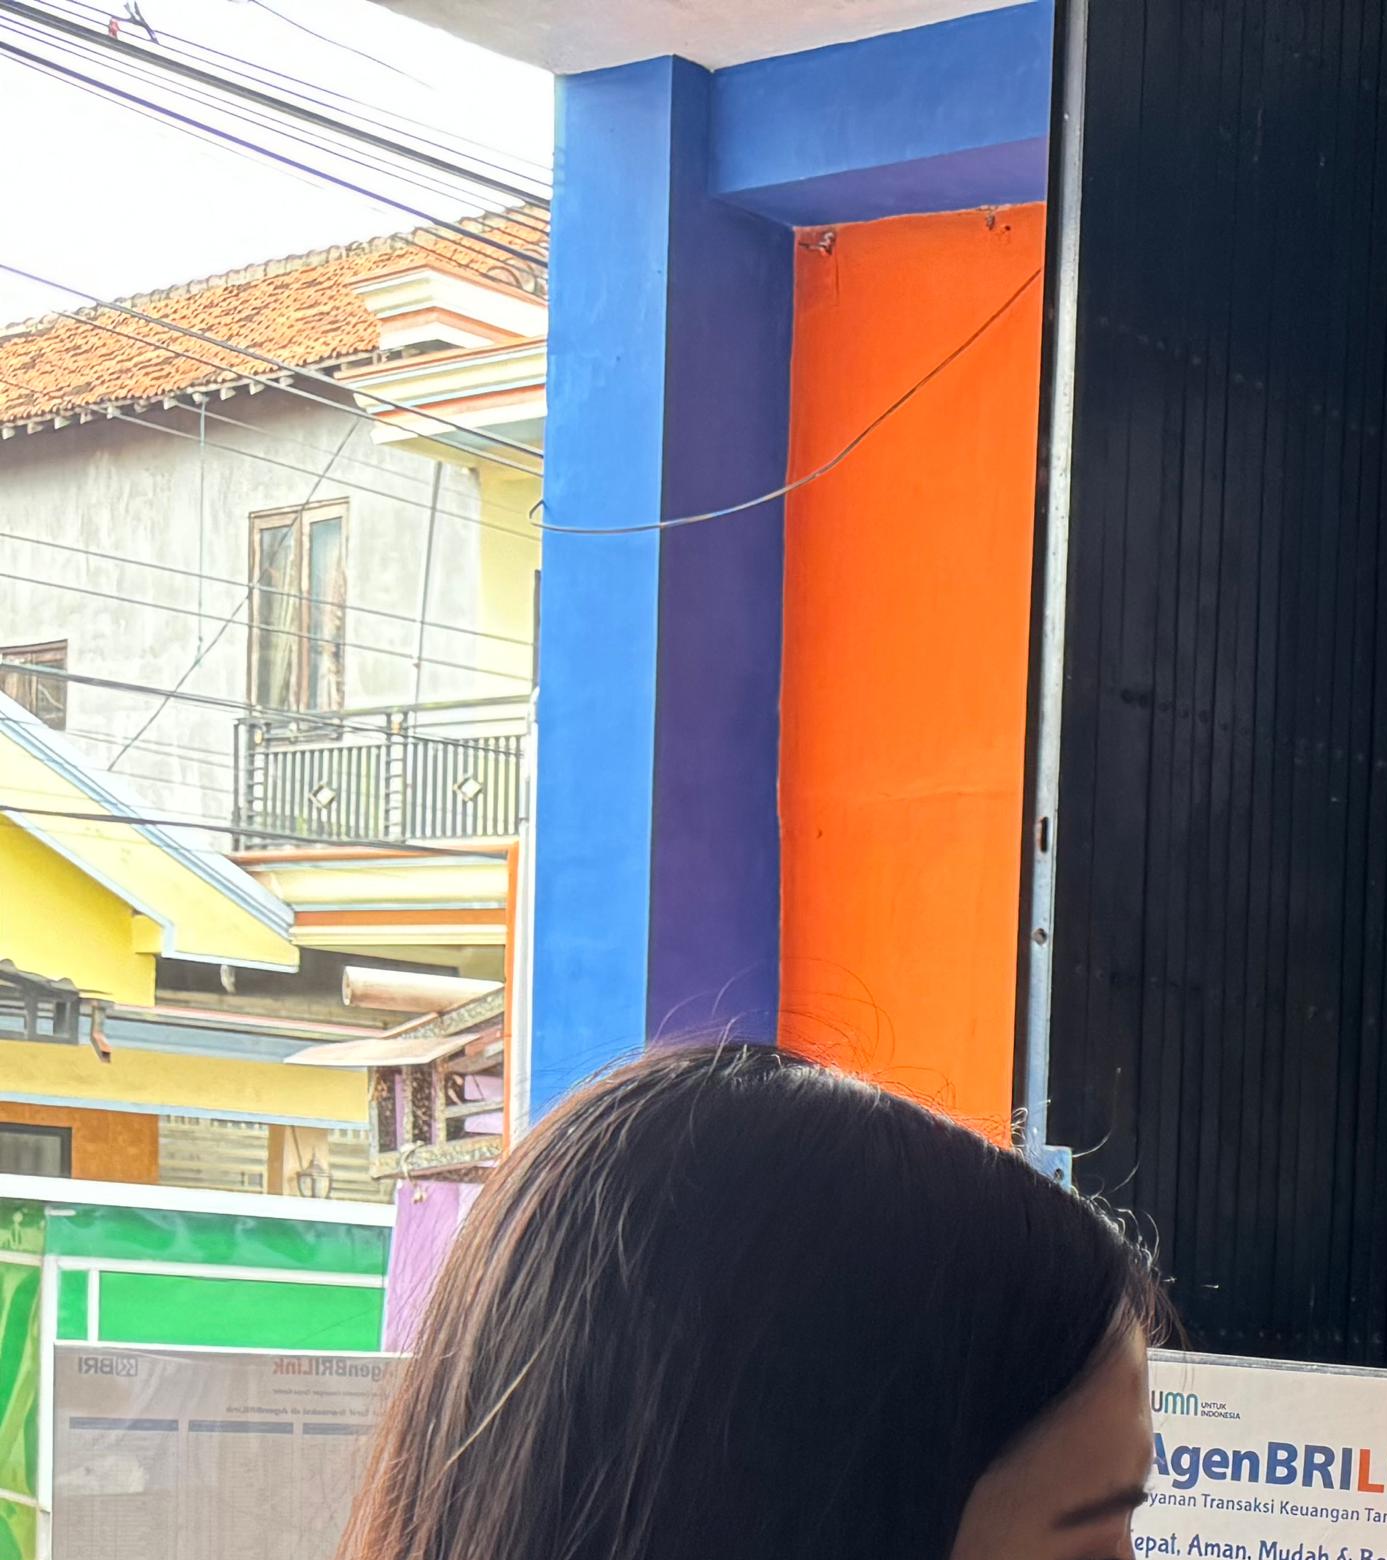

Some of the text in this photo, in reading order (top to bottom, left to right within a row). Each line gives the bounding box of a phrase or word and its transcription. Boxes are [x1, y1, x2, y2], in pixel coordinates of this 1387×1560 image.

[1201, 1402, 1227, 1410] UNTUK
[1201, 1410, 1240, 1420] INDONESIA
[1201, 1493, 1275, 1516] Transaksi
[1279, 1499, 1360, 1523] Keuangan
